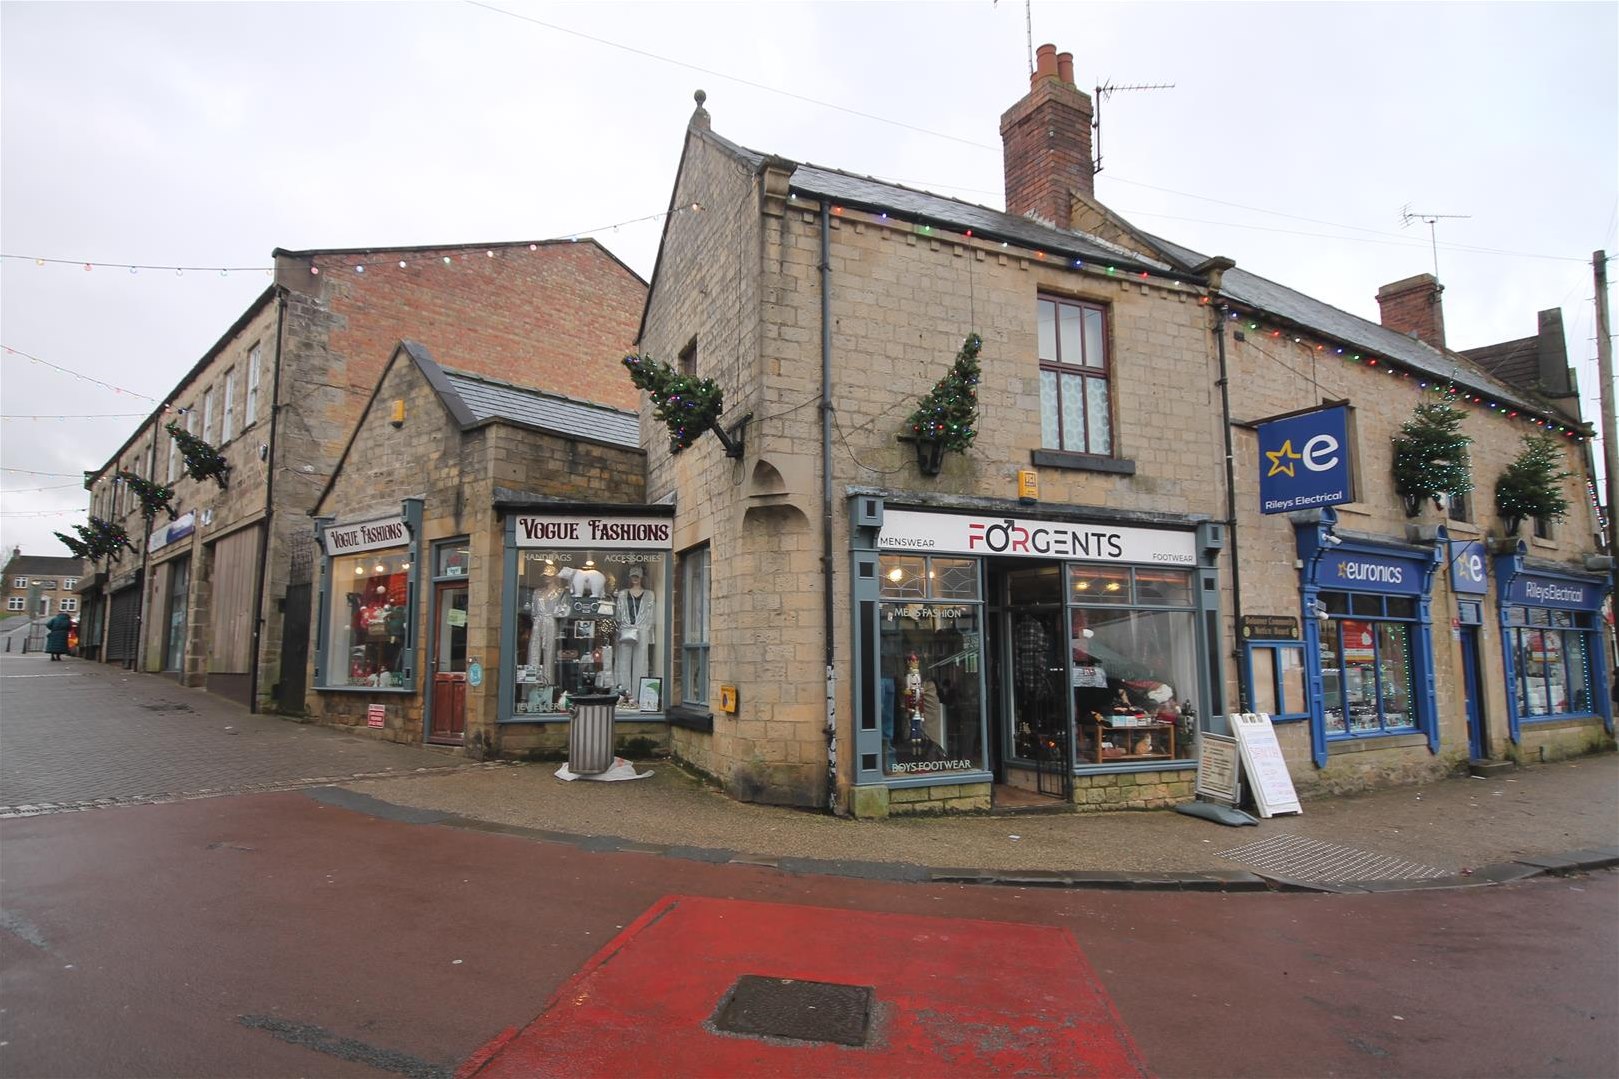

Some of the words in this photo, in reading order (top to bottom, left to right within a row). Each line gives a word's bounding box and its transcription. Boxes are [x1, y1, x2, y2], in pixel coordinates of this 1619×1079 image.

[1303, 434, 1339, 472] e
[1265, 500, 1294, 510] Rileys
[1295, 491, 1342, 505] Electrical
[331, 530, 359, 548] VOGUE
[360, 523, 403, 544] FASHIONS
[519, 518, 579, 540] VOGUE
[588, 519, 669, 541] FASHIONS
[880, 538, 935, 547] MENSWEAR
[604, 554, 661, 563] ACCESSORIES
[1153, 553, 1193, 563] FOOTWEAR
[1346, 562, 1402, 583] euronics
[918, 759, 971, 772] FOOTWEAR
